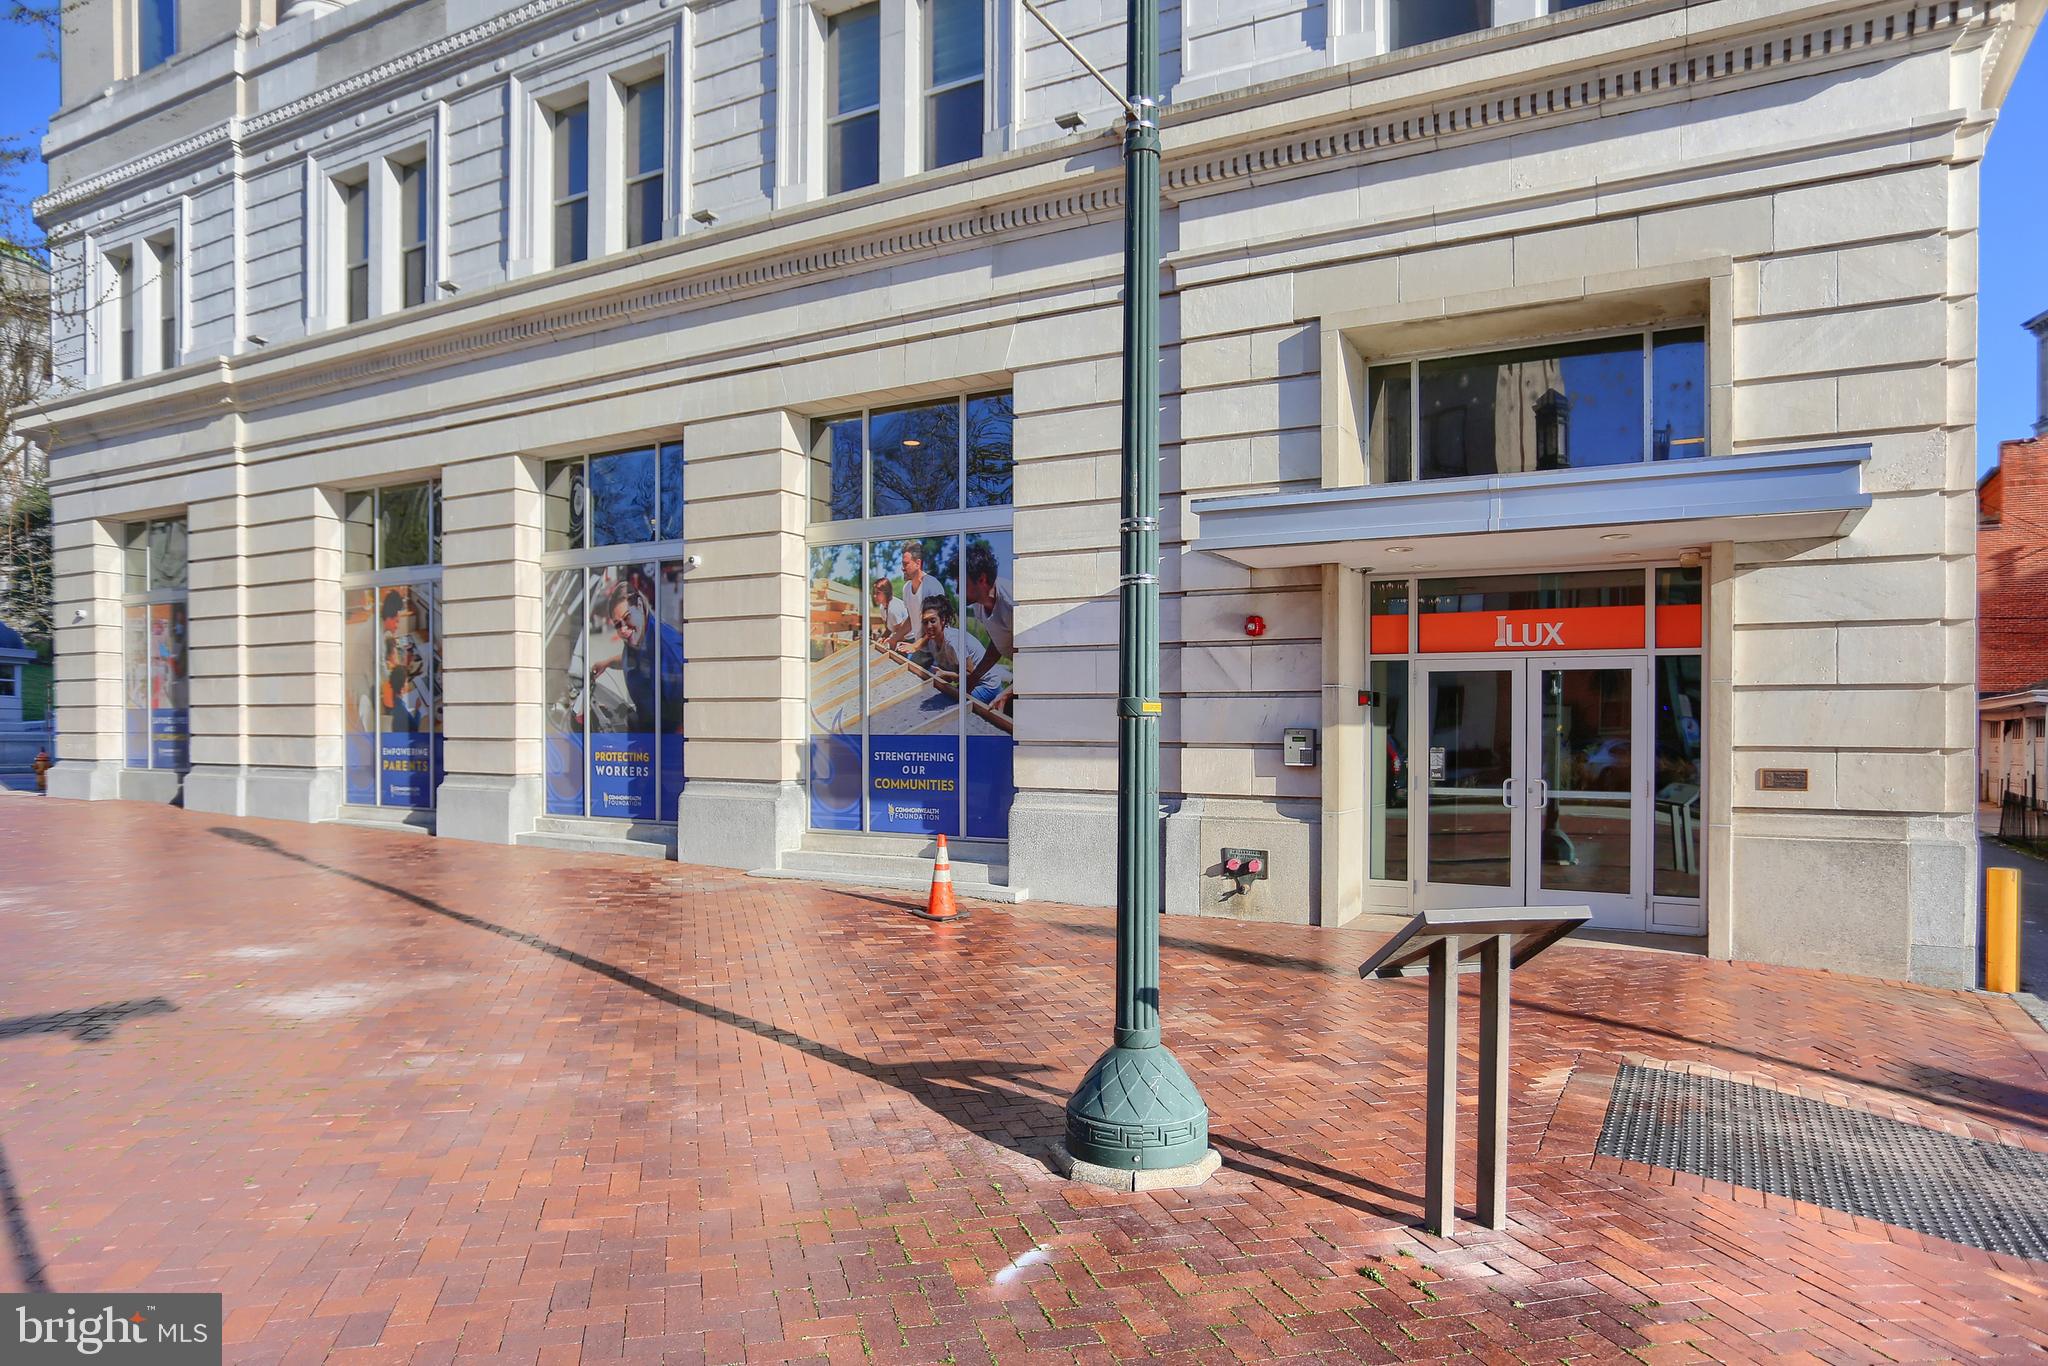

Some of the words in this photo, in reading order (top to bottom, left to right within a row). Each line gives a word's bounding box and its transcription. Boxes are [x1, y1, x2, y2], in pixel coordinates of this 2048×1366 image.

[595, 752, 649, 762] PROTECTING
[874, 752, 954, 762] STRENGTHENING
[383, 760, 428, 771] PARENTS
[902, 765, 926, 775] OUR
[595, 765, 649, 777] WORKERS
[874, 778, 954, 791] COMMUNITIES
